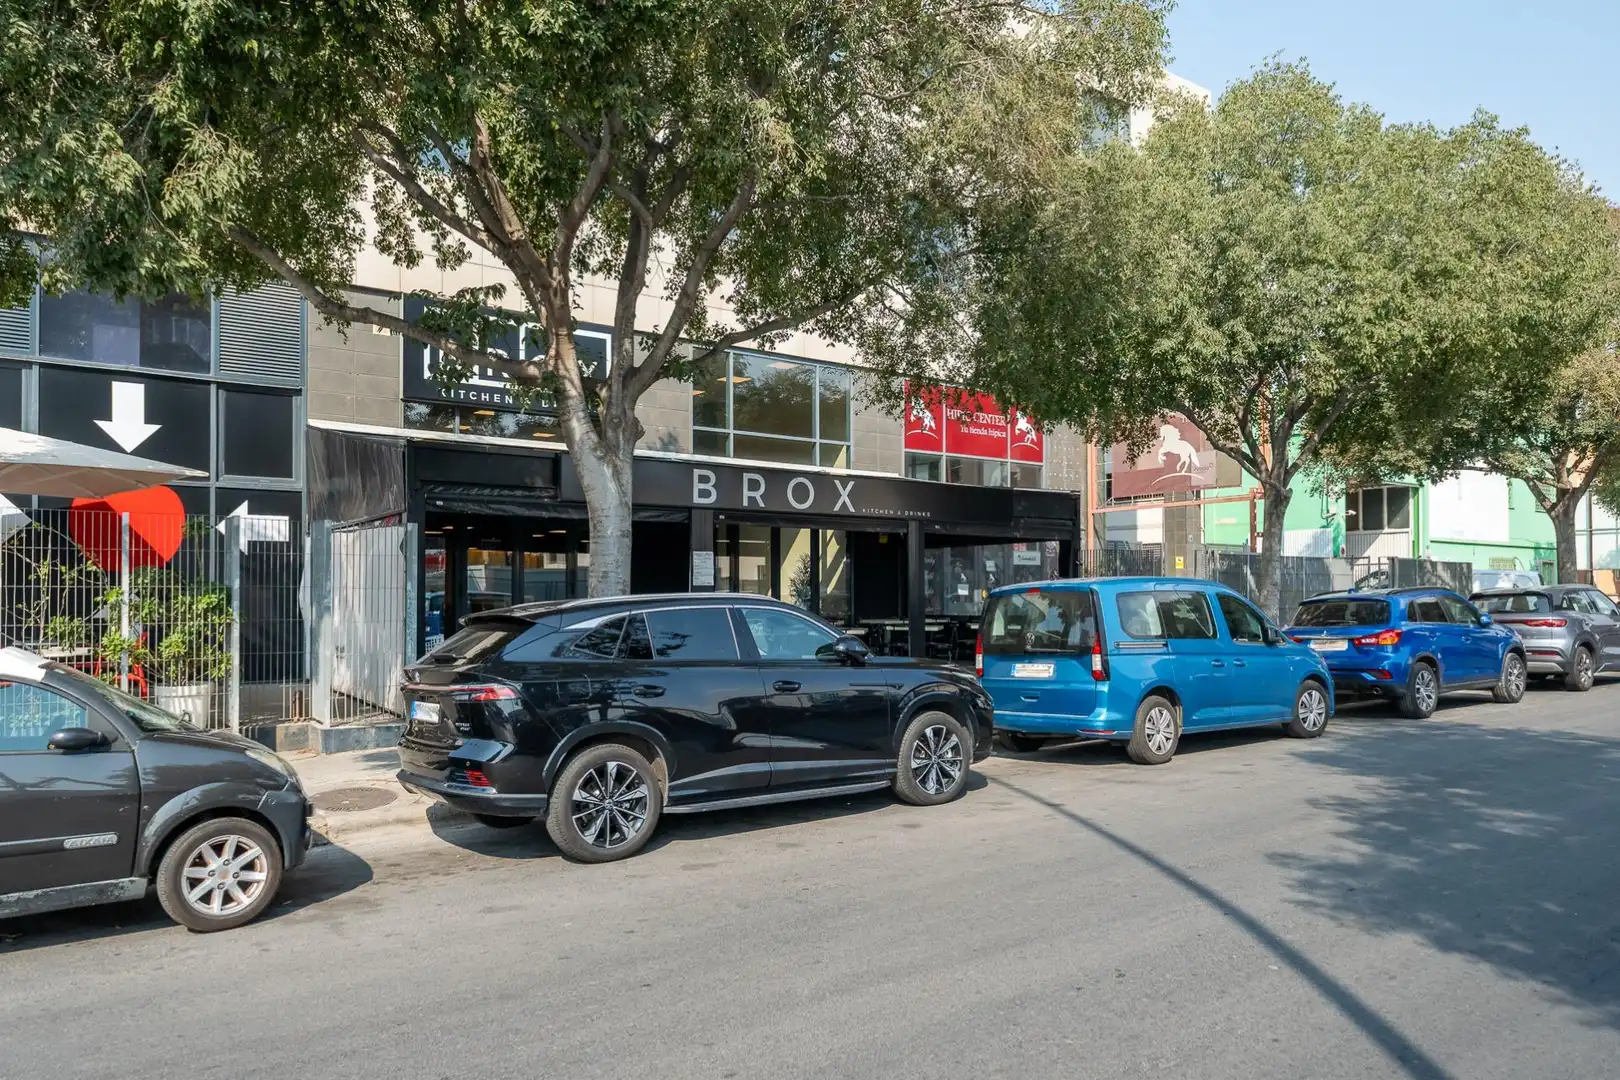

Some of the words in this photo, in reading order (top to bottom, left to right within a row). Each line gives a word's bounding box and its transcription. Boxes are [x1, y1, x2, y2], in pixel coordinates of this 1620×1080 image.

[973, 412, 1006, 426] CENTER
[969, 425, 987, 435] tienda
[692, 468, 856, 513] BROX
